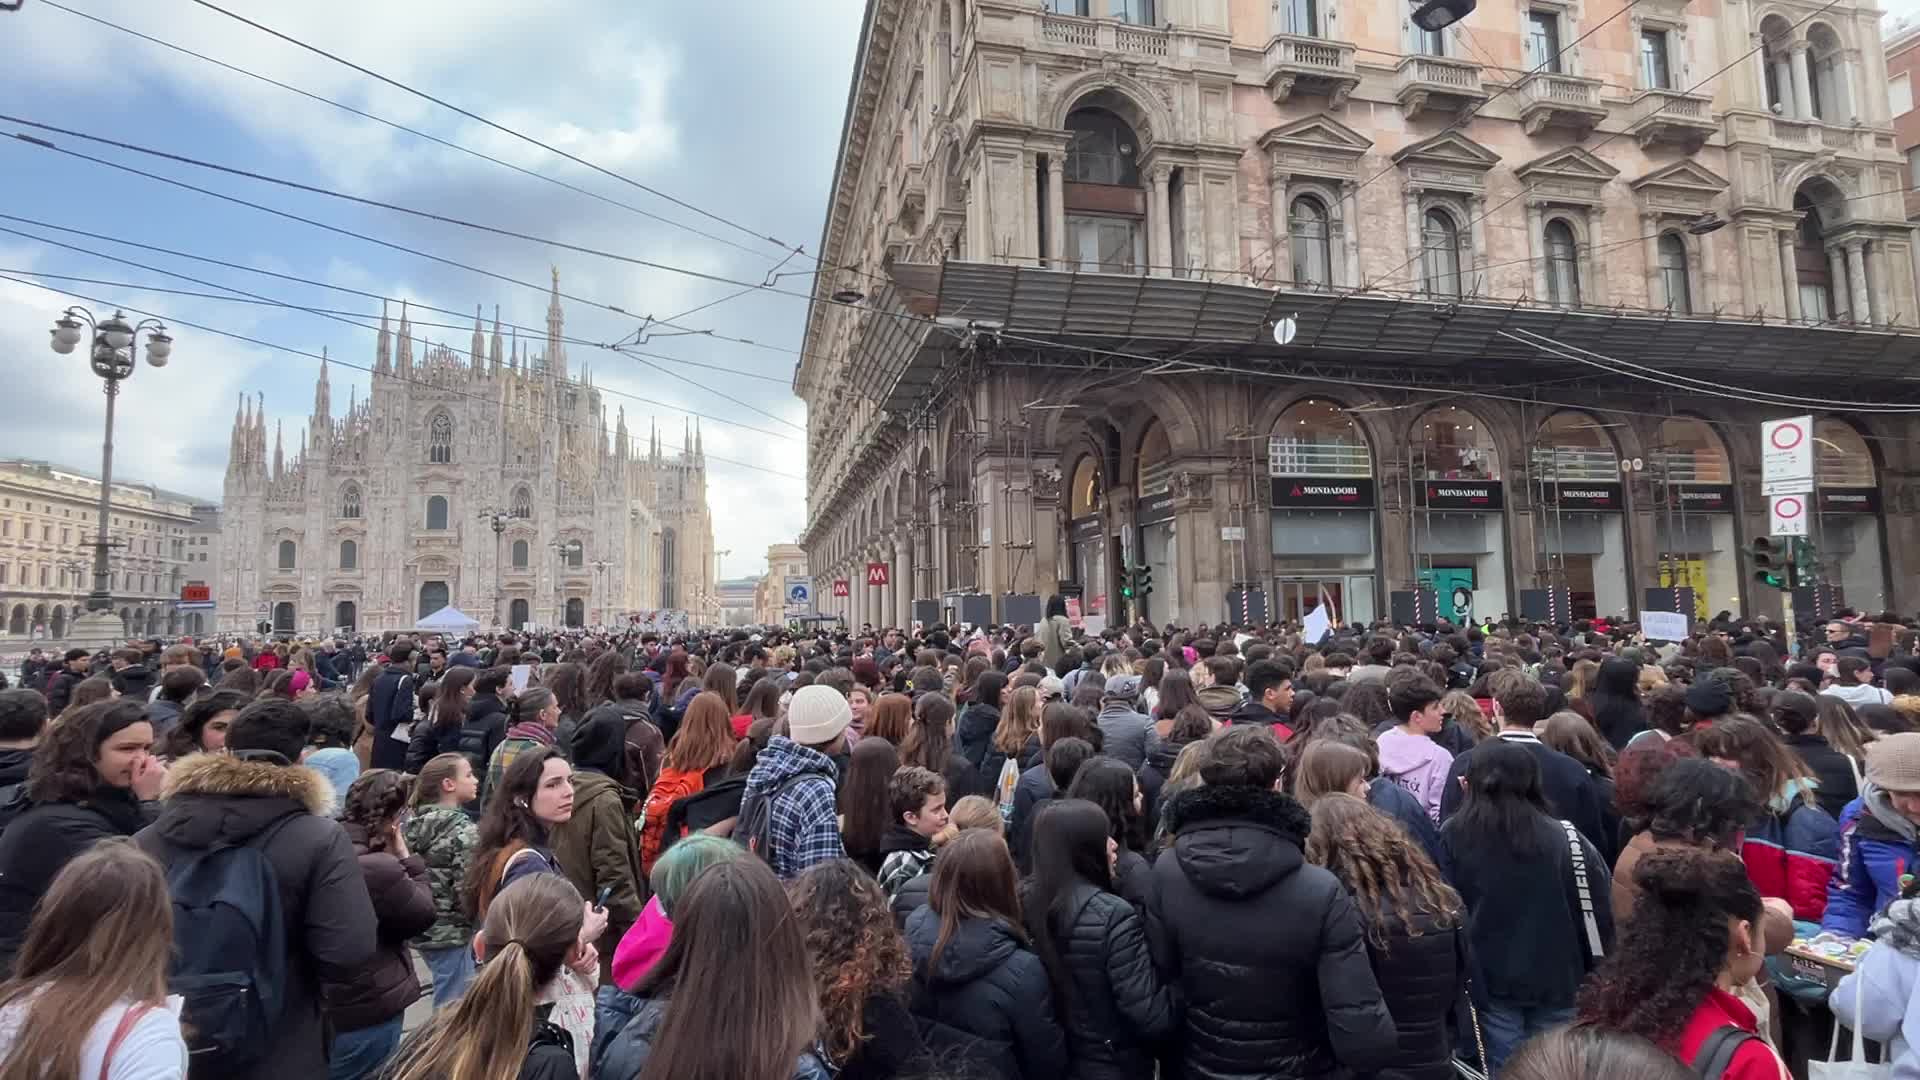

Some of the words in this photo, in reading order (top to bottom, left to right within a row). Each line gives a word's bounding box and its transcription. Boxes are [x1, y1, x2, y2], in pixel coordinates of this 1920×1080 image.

[1303, 486, 1357, 495] MONDADORI
[1438, 488, 1488, 497] MONDADORI
[868, 568, 886, 581] M
[835, 584, 848, 593] M
